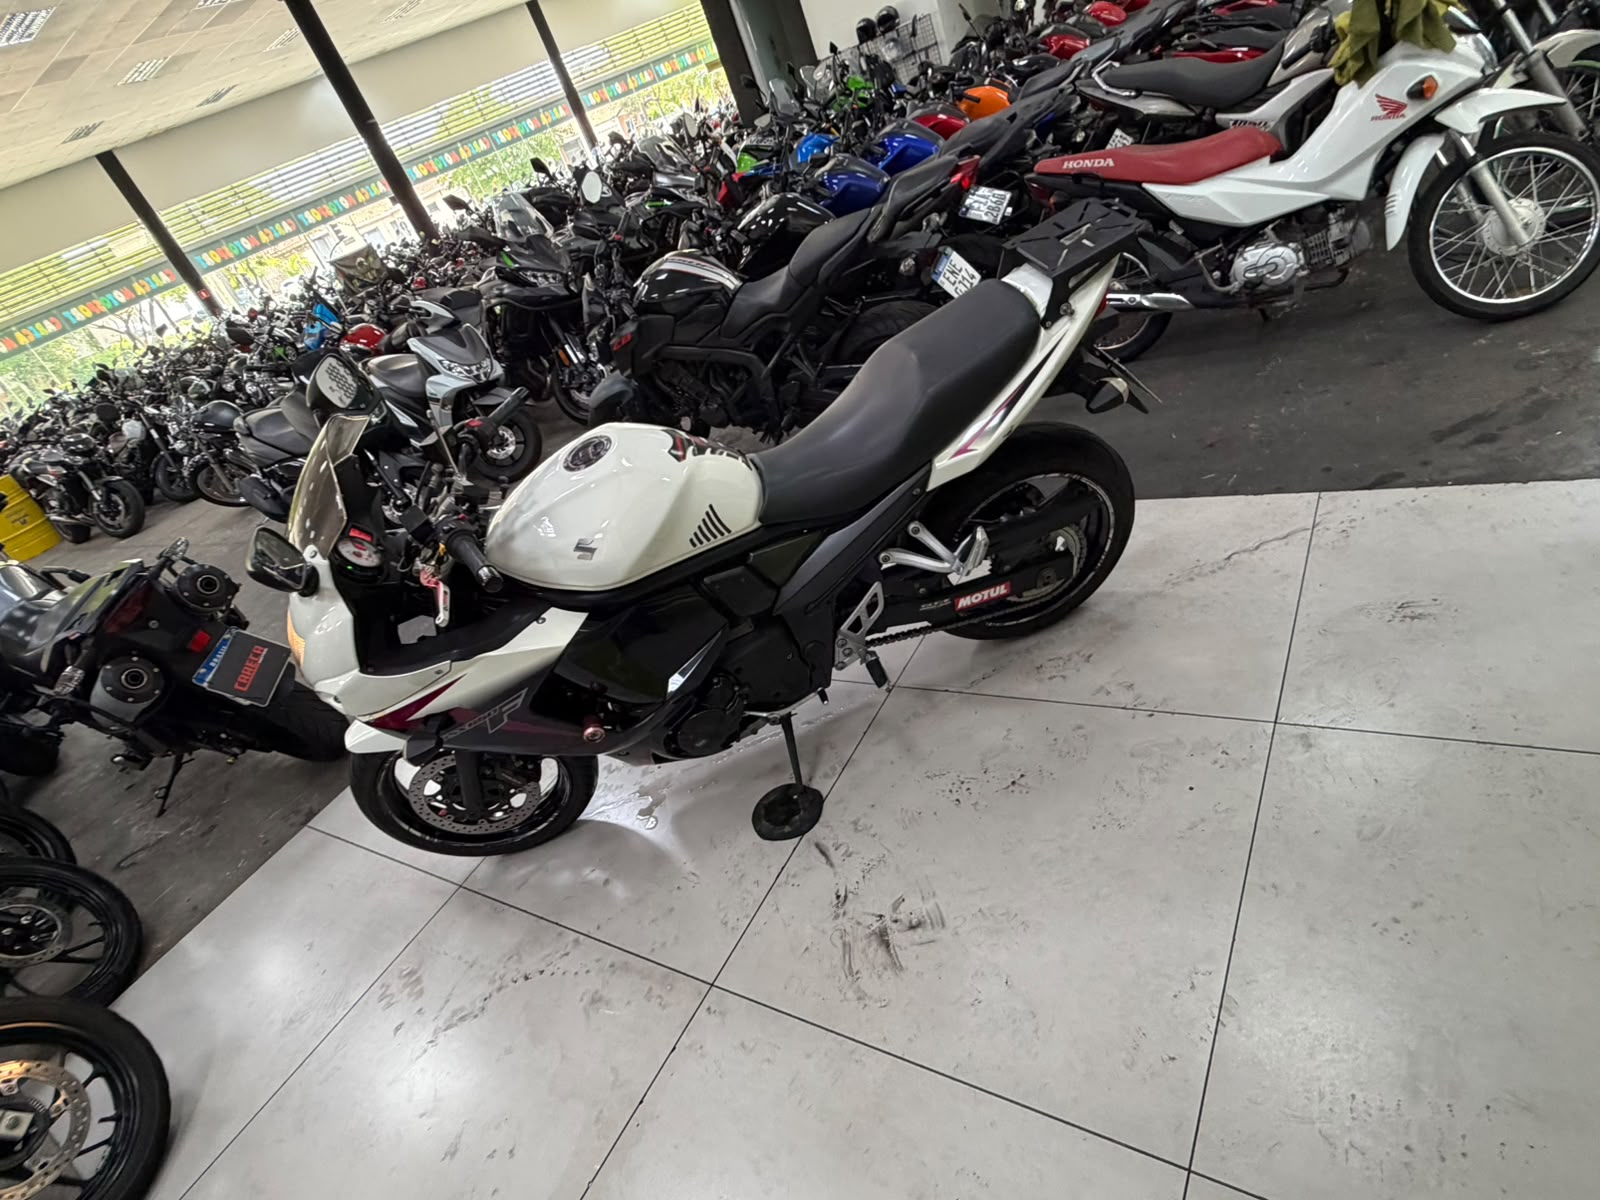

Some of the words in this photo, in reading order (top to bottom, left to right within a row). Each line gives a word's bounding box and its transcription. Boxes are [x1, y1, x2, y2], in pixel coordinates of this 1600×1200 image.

[1062, 158, 1115, 169] HONDA
[943, 260, 963, 286] ENE
[957, 584, 1008, 609] MOTUL
[234, 645, 266, 692] CARECA
